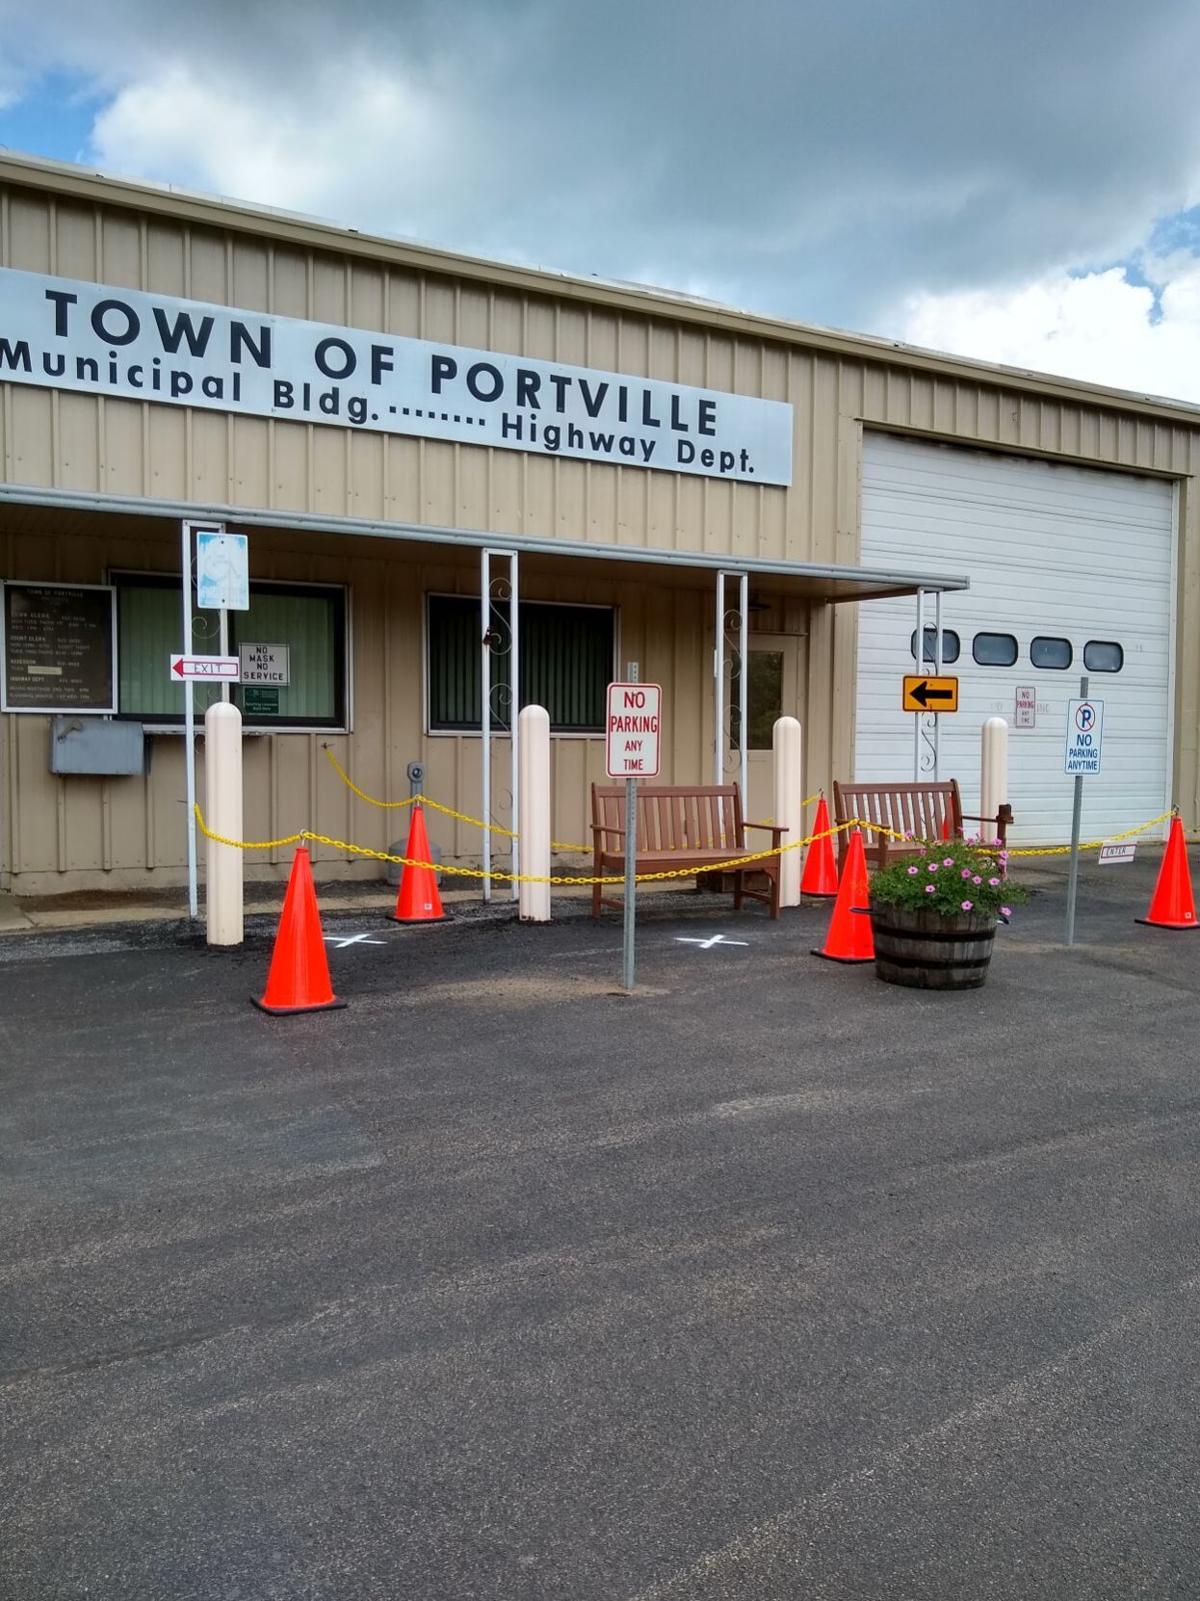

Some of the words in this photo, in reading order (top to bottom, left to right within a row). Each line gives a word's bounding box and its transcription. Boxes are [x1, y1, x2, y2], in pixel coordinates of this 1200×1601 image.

[45, 289, 272, 369] TOWN
[314, 337, 394, 386] OF
[431, 354, 717, 437] PORTVILLE
[0, 338, 241, 402] Municipal
[501, 412, 656, 462] Highway
[677, 440, 755, 474] Dept.
[256, 646, 268, 654] NO
[194, 663, 222, 673] EXIT
[257, 663, 268, 671] NO
[243, 672, 284, 681] SERVICE
[624, 691, 646, 709] NO
[1021, 691, 1030, 699] NO
[610, 715, 658, 733] PARKING
[624, 740, 643, 752] ANY
[1076, 734, 1092, 747] NO
[1069, 748, 1098, 760] PARKING
[623, 758, 644, 771] TIME
[1067, 760, 1098, 771] ANYTIME
